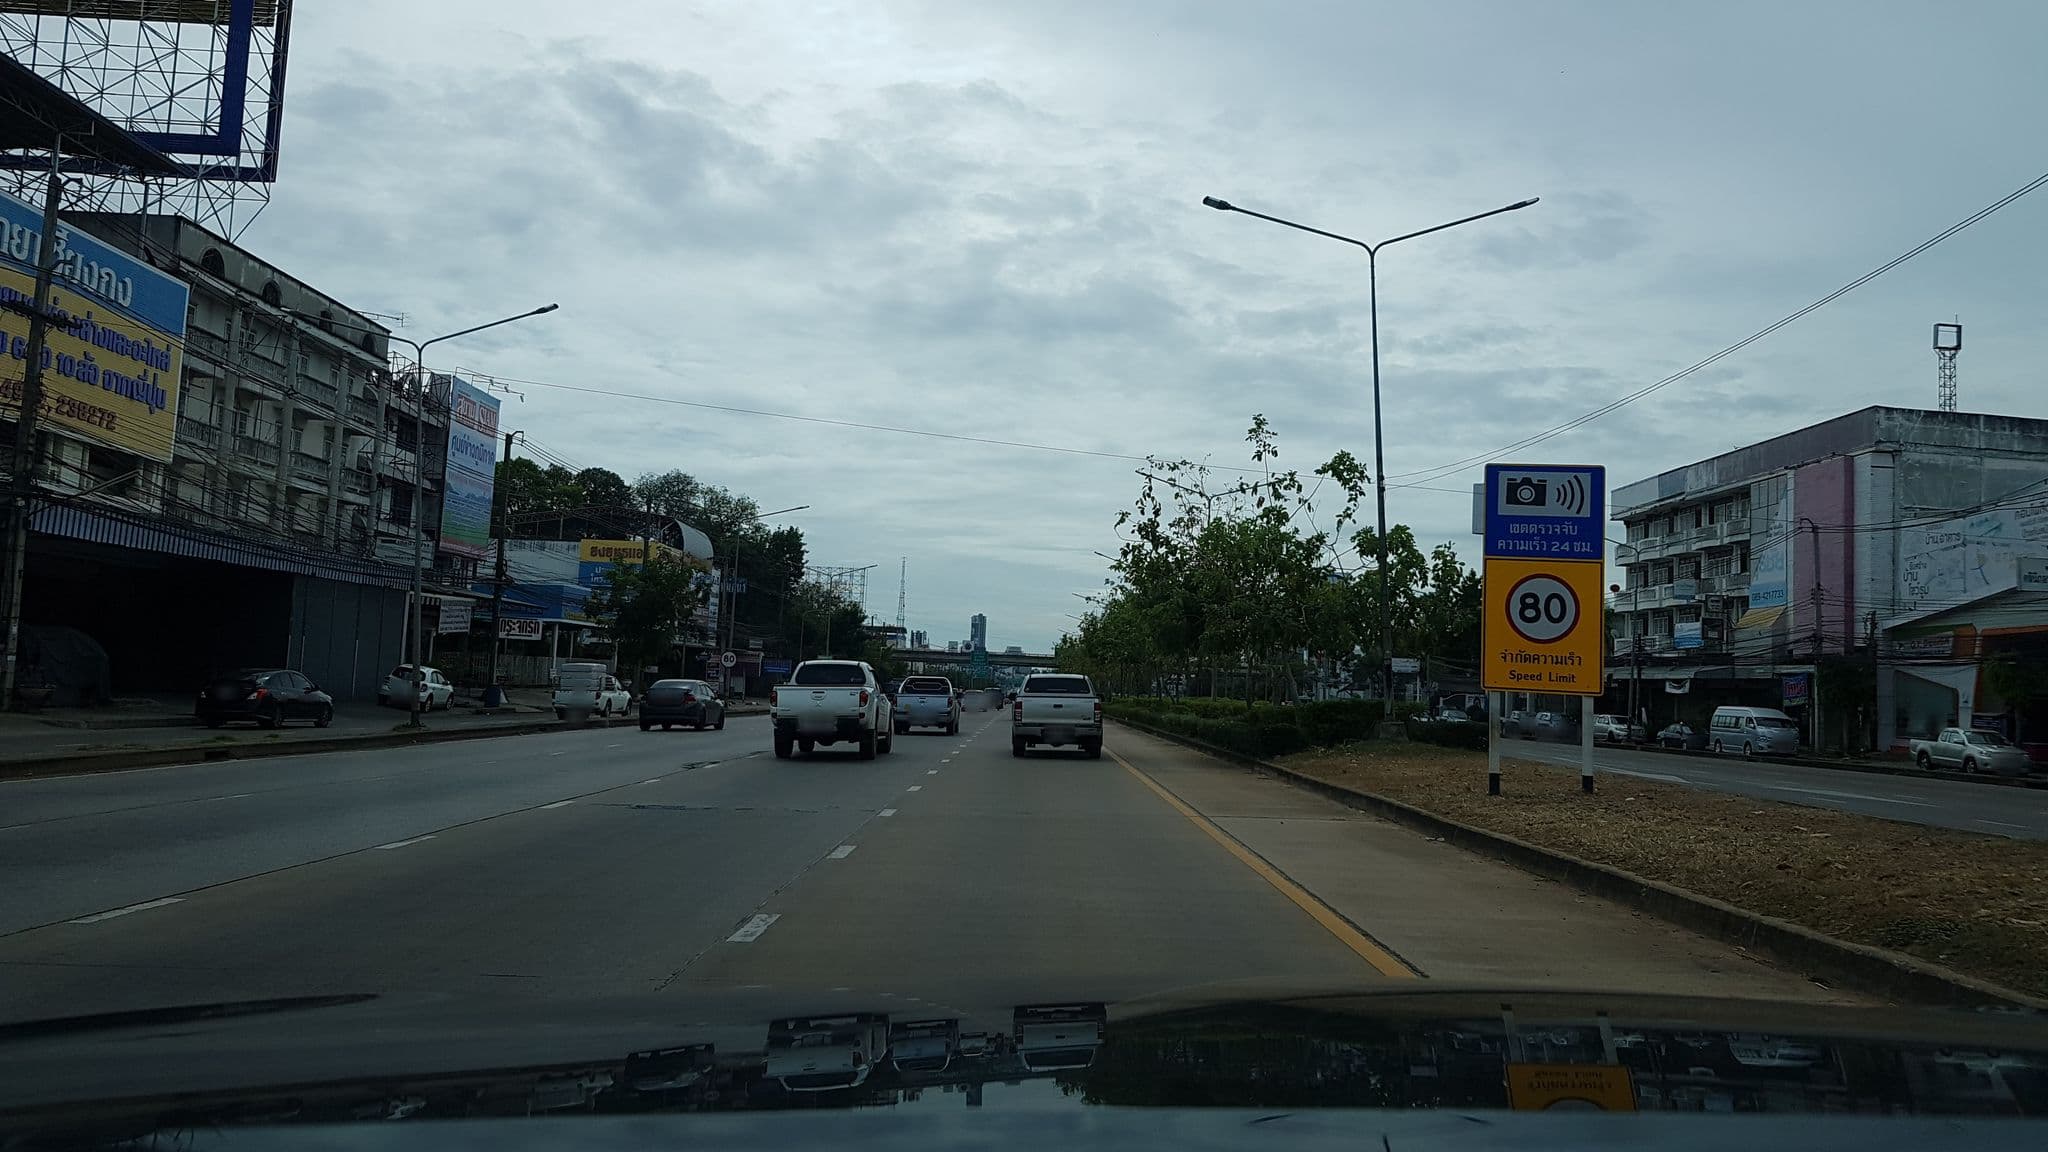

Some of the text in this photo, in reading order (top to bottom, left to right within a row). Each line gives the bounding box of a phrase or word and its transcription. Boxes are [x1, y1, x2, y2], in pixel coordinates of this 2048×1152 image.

[1509, 521, 1578, 535] เขตตรวจจับ
[1497, 536, 1593, 552] ความเร็ว 24 ชม.
[1518, 592, 1567, 624] 80
[723, 655, 735, 663] 80
[1500, 649, 1582, 666] จำกัดความเร็ว
[1509, 669, 1576, 683] Speed Limit
